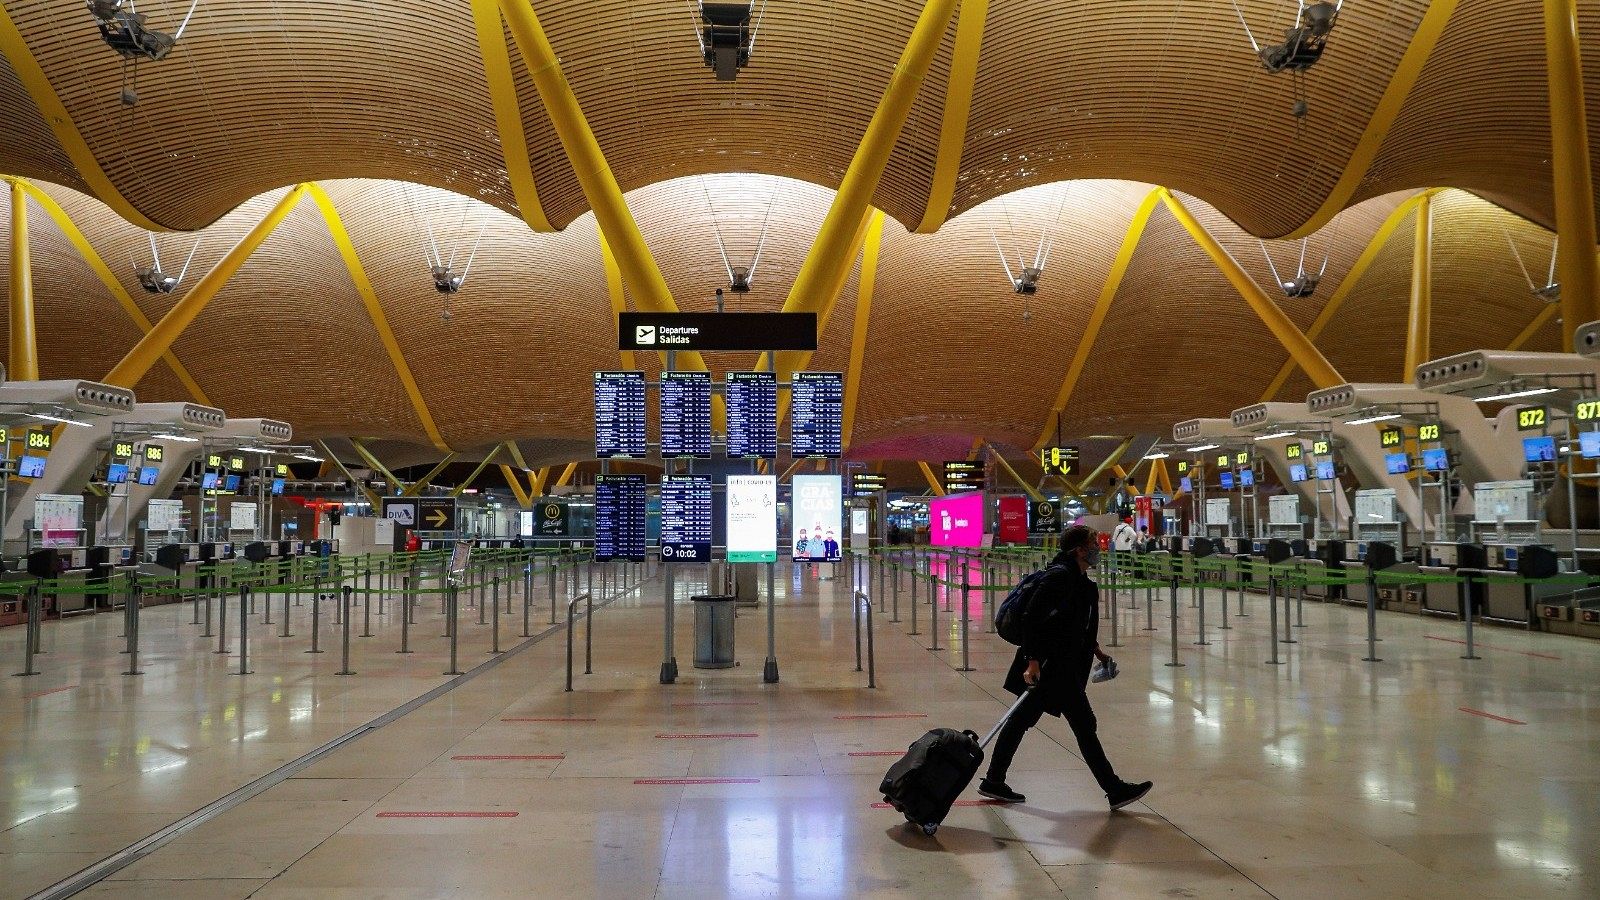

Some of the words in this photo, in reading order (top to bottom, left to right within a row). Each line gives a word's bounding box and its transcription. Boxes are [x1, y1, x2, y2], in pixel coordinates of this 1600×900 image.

[659, 326, 699, 335] Departures
[659, 335, 690, 344] Salidas
[1519, 409, 1545, 427] 872
[1382, 430, 1400, 445] 874
[1419, 424, 1439, 440] 873
[29, 433, 50, 448] 884
[116, 443, 132, 457] 885
[147, 447, 162, 460] 886
[1287, 445, 1300, 458] 876
[1313, 441, 1328, 455] 875
[209, 455, 221, 467] 887
[675, 550, 697, 558] 10:02
